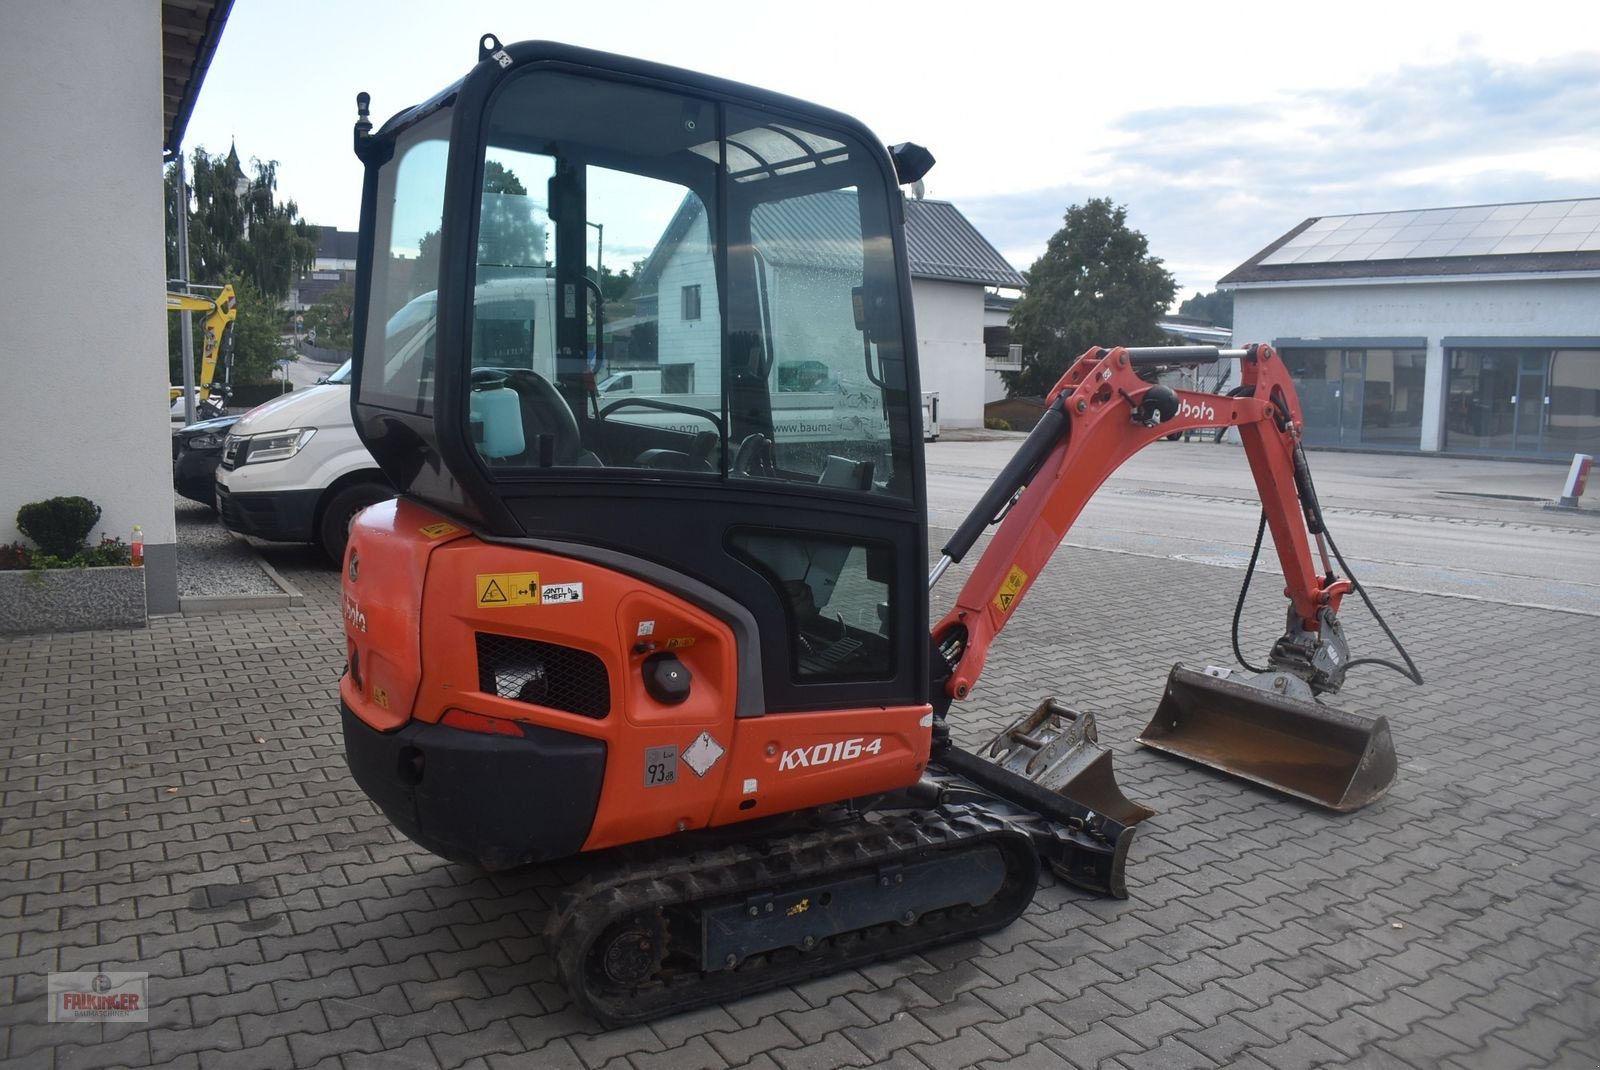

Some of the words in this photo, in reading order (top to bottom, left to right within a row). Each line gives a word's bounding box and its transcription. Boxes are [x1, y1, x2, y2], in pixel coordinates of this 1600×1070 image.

[773, 422, 832, 433] www.bauma
[543, 592, 567, 600] THEFT
[778, 738, 882, 771] KX016-4
[648, 763, 665, 783] 93
